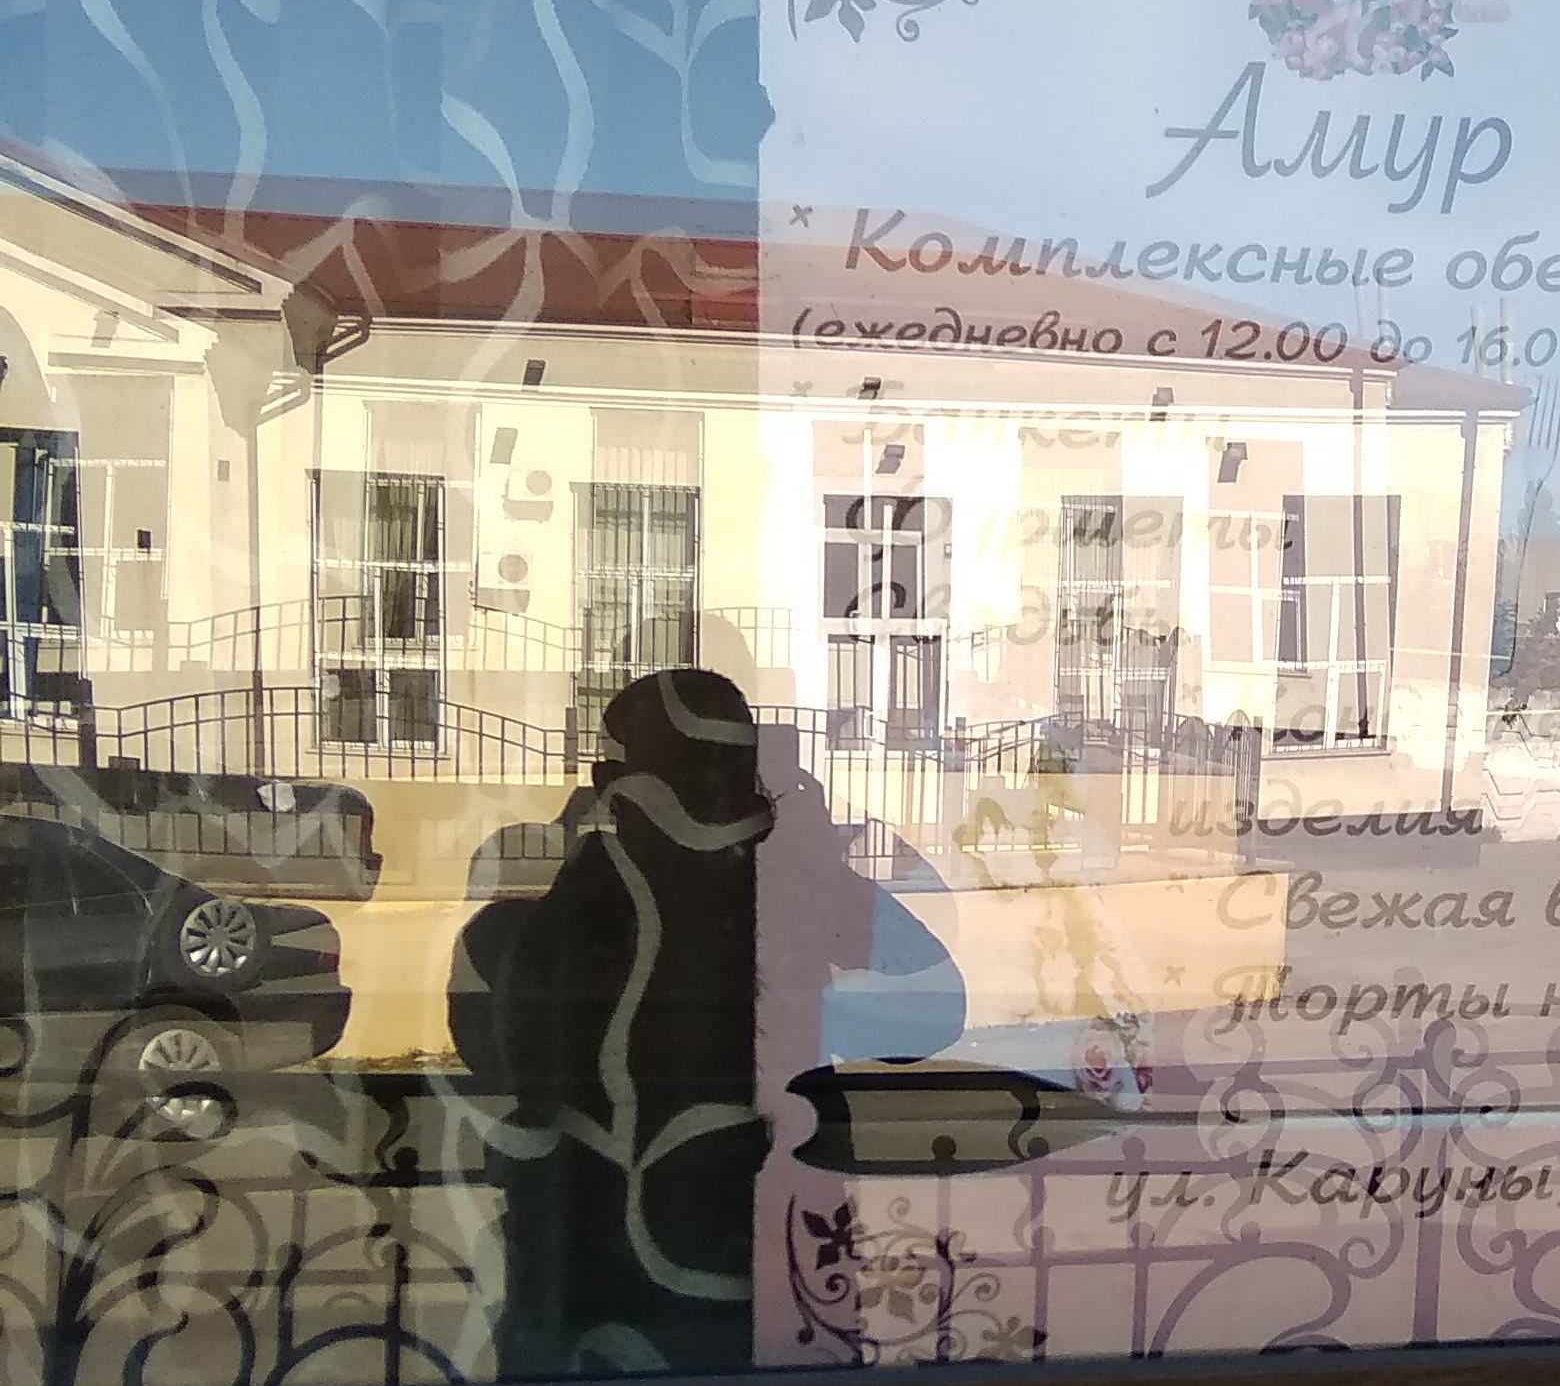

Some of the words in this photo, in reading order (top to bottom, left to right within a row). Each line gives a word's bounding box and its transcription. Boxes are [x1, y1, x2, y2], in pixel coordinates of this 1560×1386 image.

[1145, 61, 1513, 215] Амур
[843, 207, 1415, 289] Комплексные
[790, 306, 1124, 355] (ежедневно
[1147, 327, 1178, 359] с
[1199, 317, 1348, 364] 12.00
[1369, 318, 1433, 364] до
[1166, 778, 1484, 839] изделия
[1217, 868, 1516, 931] Свежая
[1213, 962, 1510, 1036] Торты
[1105, 1169, 1216, 1221] ул.
